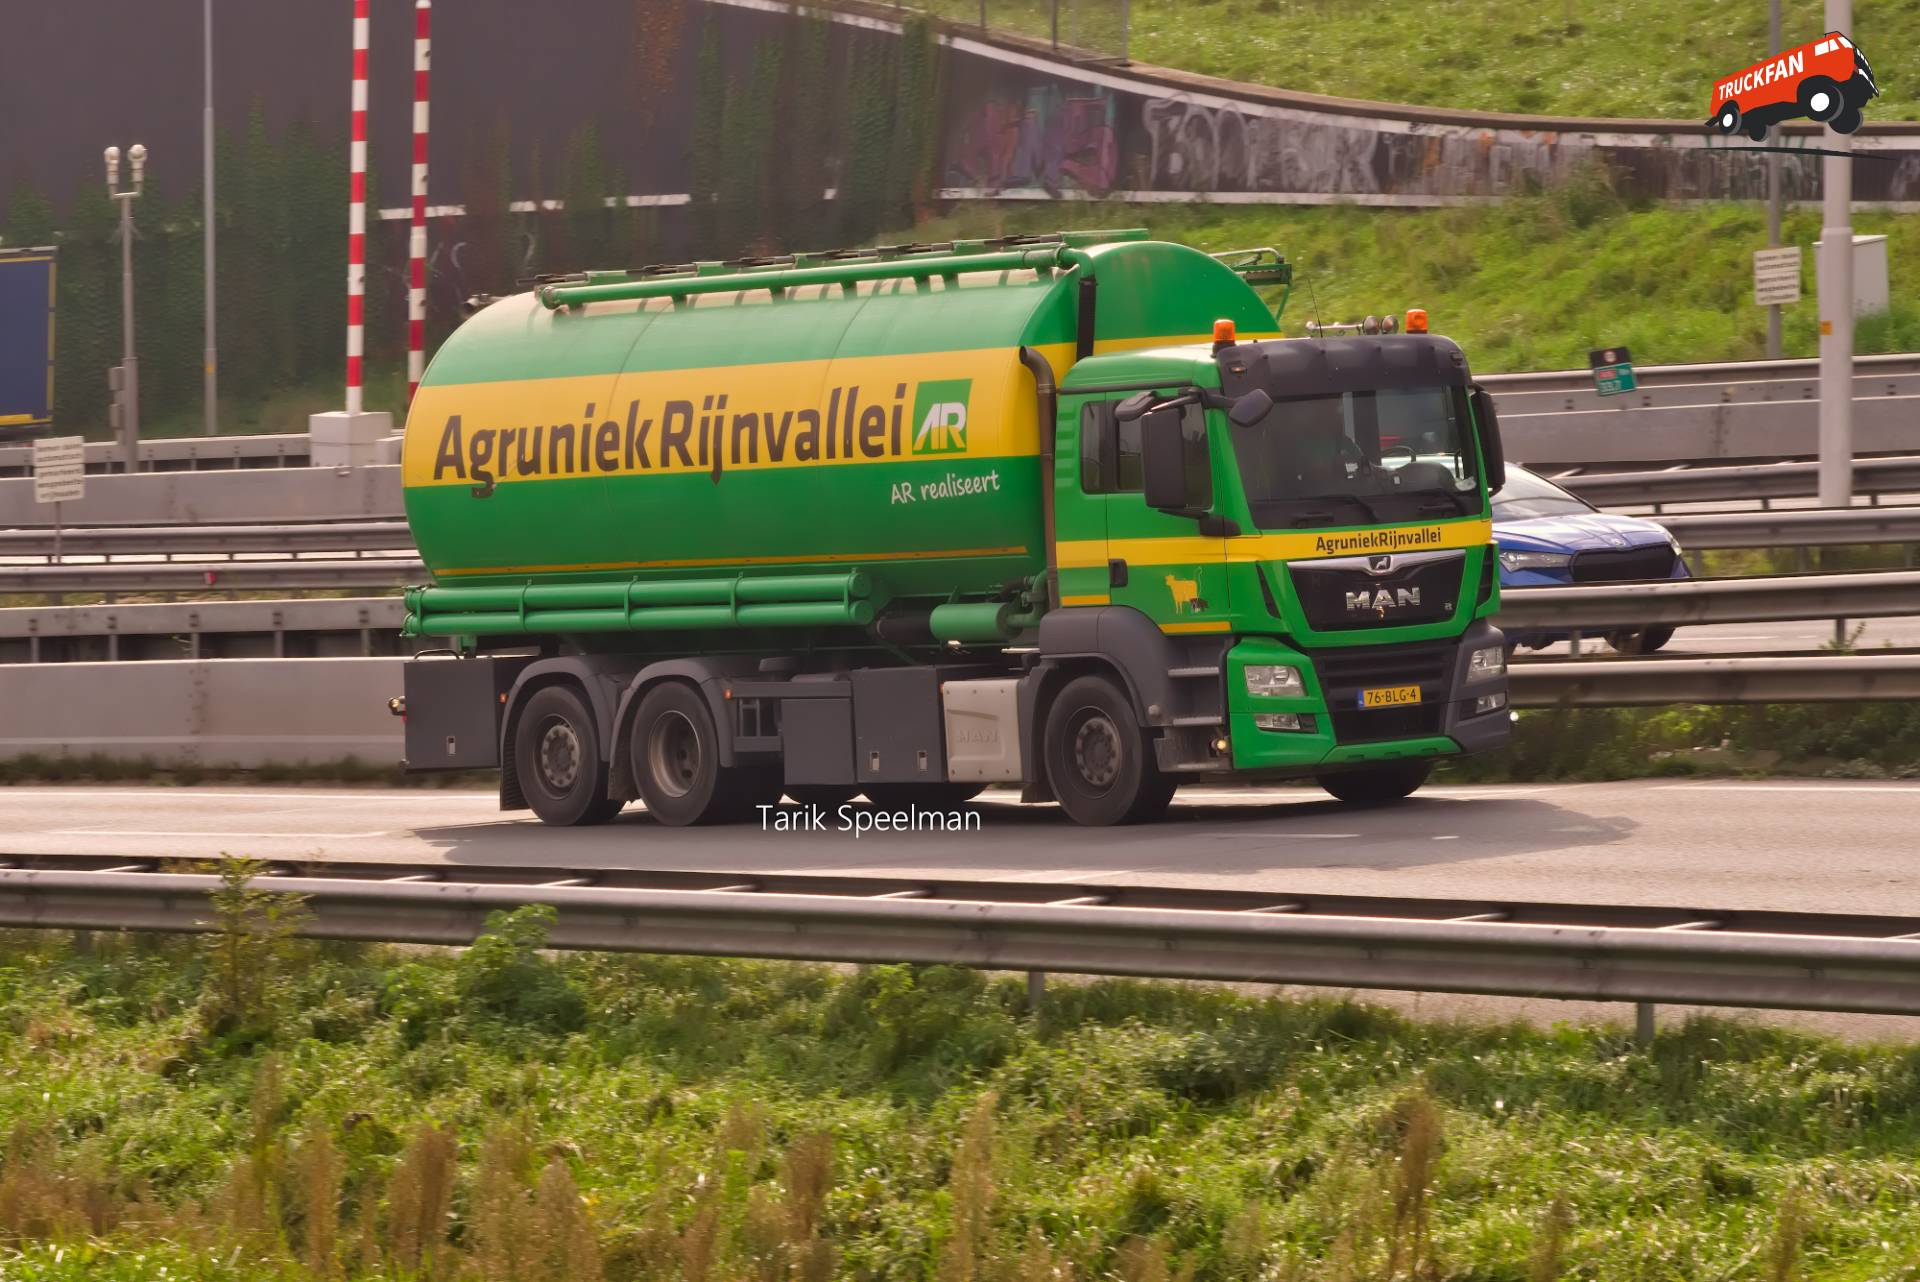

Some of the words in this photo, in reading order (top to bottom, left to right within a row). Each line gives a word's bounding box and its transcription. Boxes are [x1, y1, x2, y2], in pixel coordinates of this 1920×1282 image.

[913, 402, 967, 451] AR
[891, 482, 916, 504] AR
[920, 470, 1000, 502] realiseert
[1316, 527, 1441, 554] AgruniekRijnvallei
[1345, 587, 1421, 611] MAN
[1367, 688, 1416, 705] 76-BLG-4
